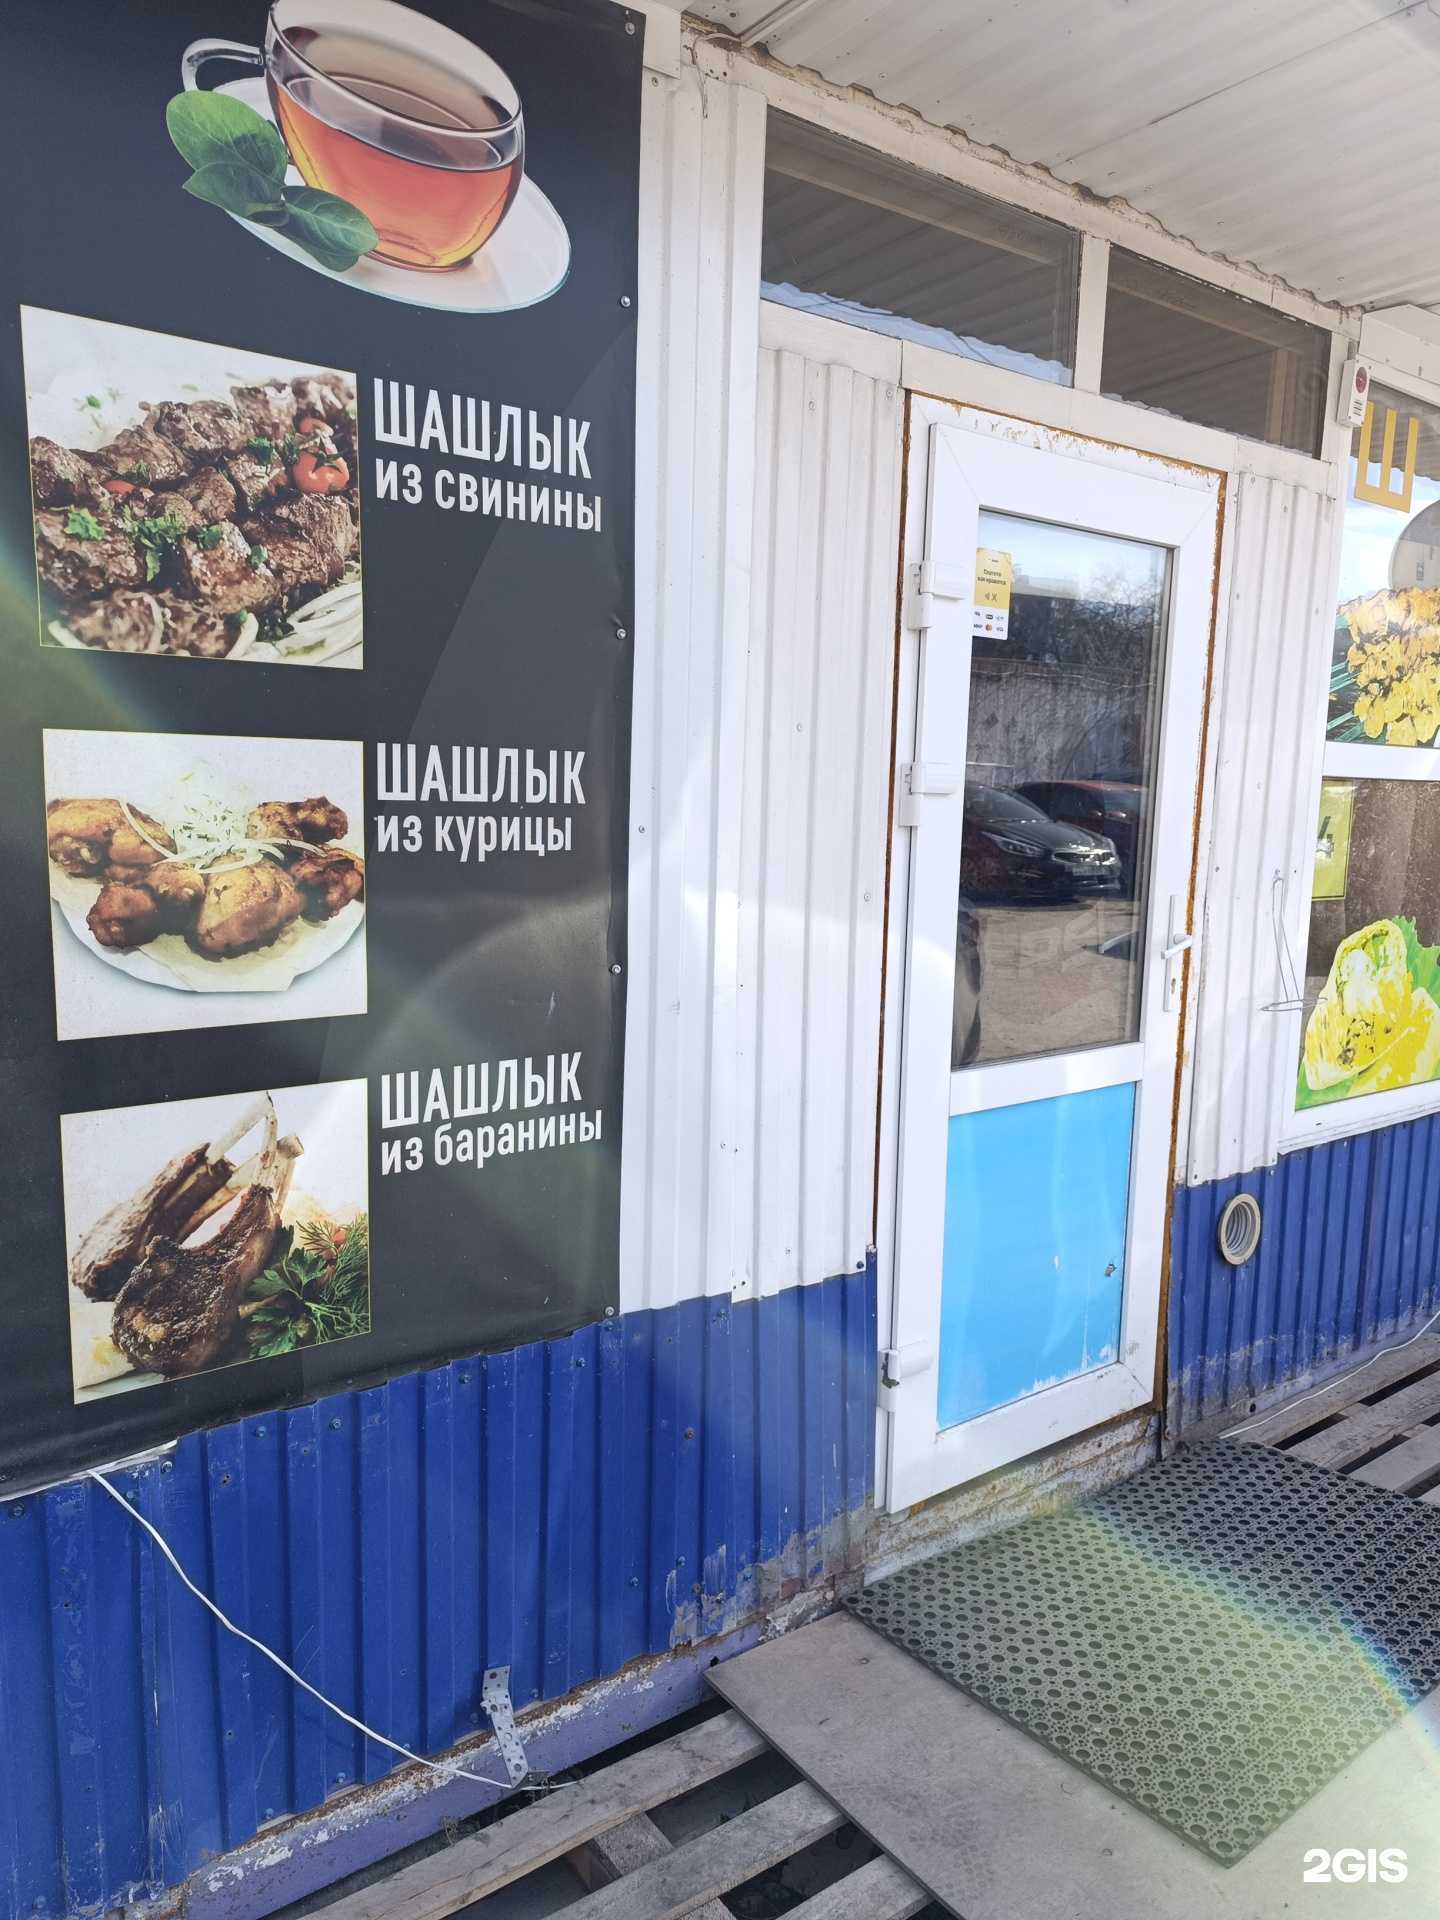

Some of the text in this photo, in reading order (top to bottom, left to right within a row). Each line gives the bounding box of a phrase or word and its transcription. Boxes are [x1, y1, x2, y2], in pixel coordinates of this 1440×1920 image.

[373, 377, 592, 479] ШАШЛЫК
[376, 742, 586, 805] ШАШЛЫК
[377, 815, 572, 863] из курицы
[381, 1051, 583, 1129] ШАШЛЫК
[381, 1109, 603, 1176] из баранины
